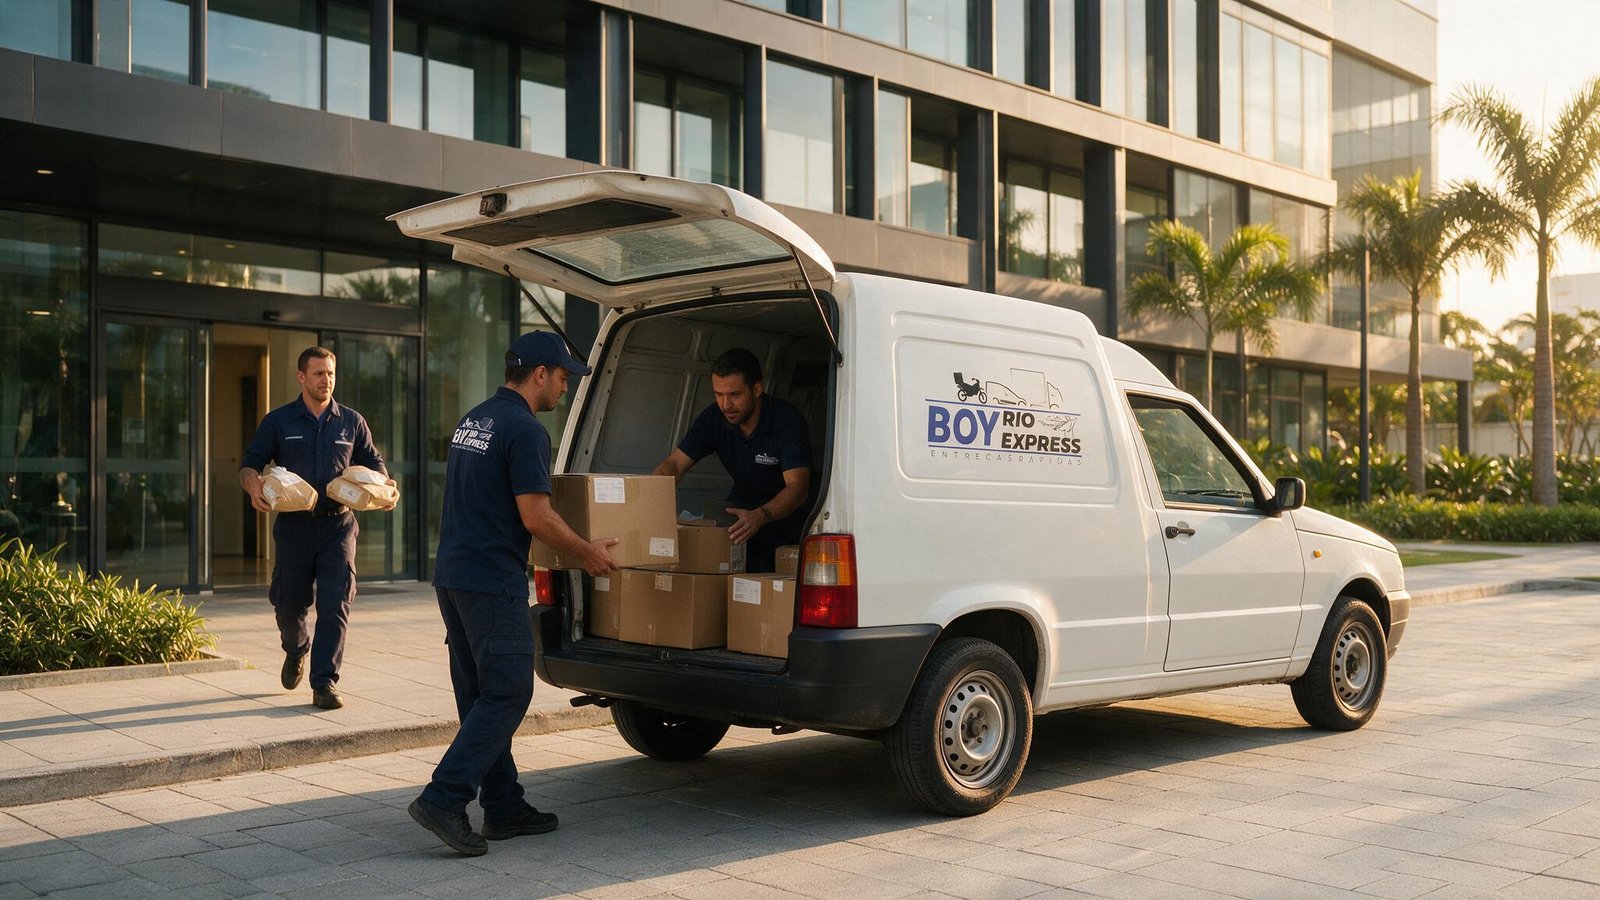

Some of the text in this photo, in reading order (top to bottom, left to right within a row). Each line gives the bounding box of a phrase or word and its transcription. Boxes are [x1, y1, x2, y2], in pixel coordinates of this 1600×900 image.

[927, 405, 1035, 446] BOY RIO
[1001, 432, 1081, 454] EXPRESS
